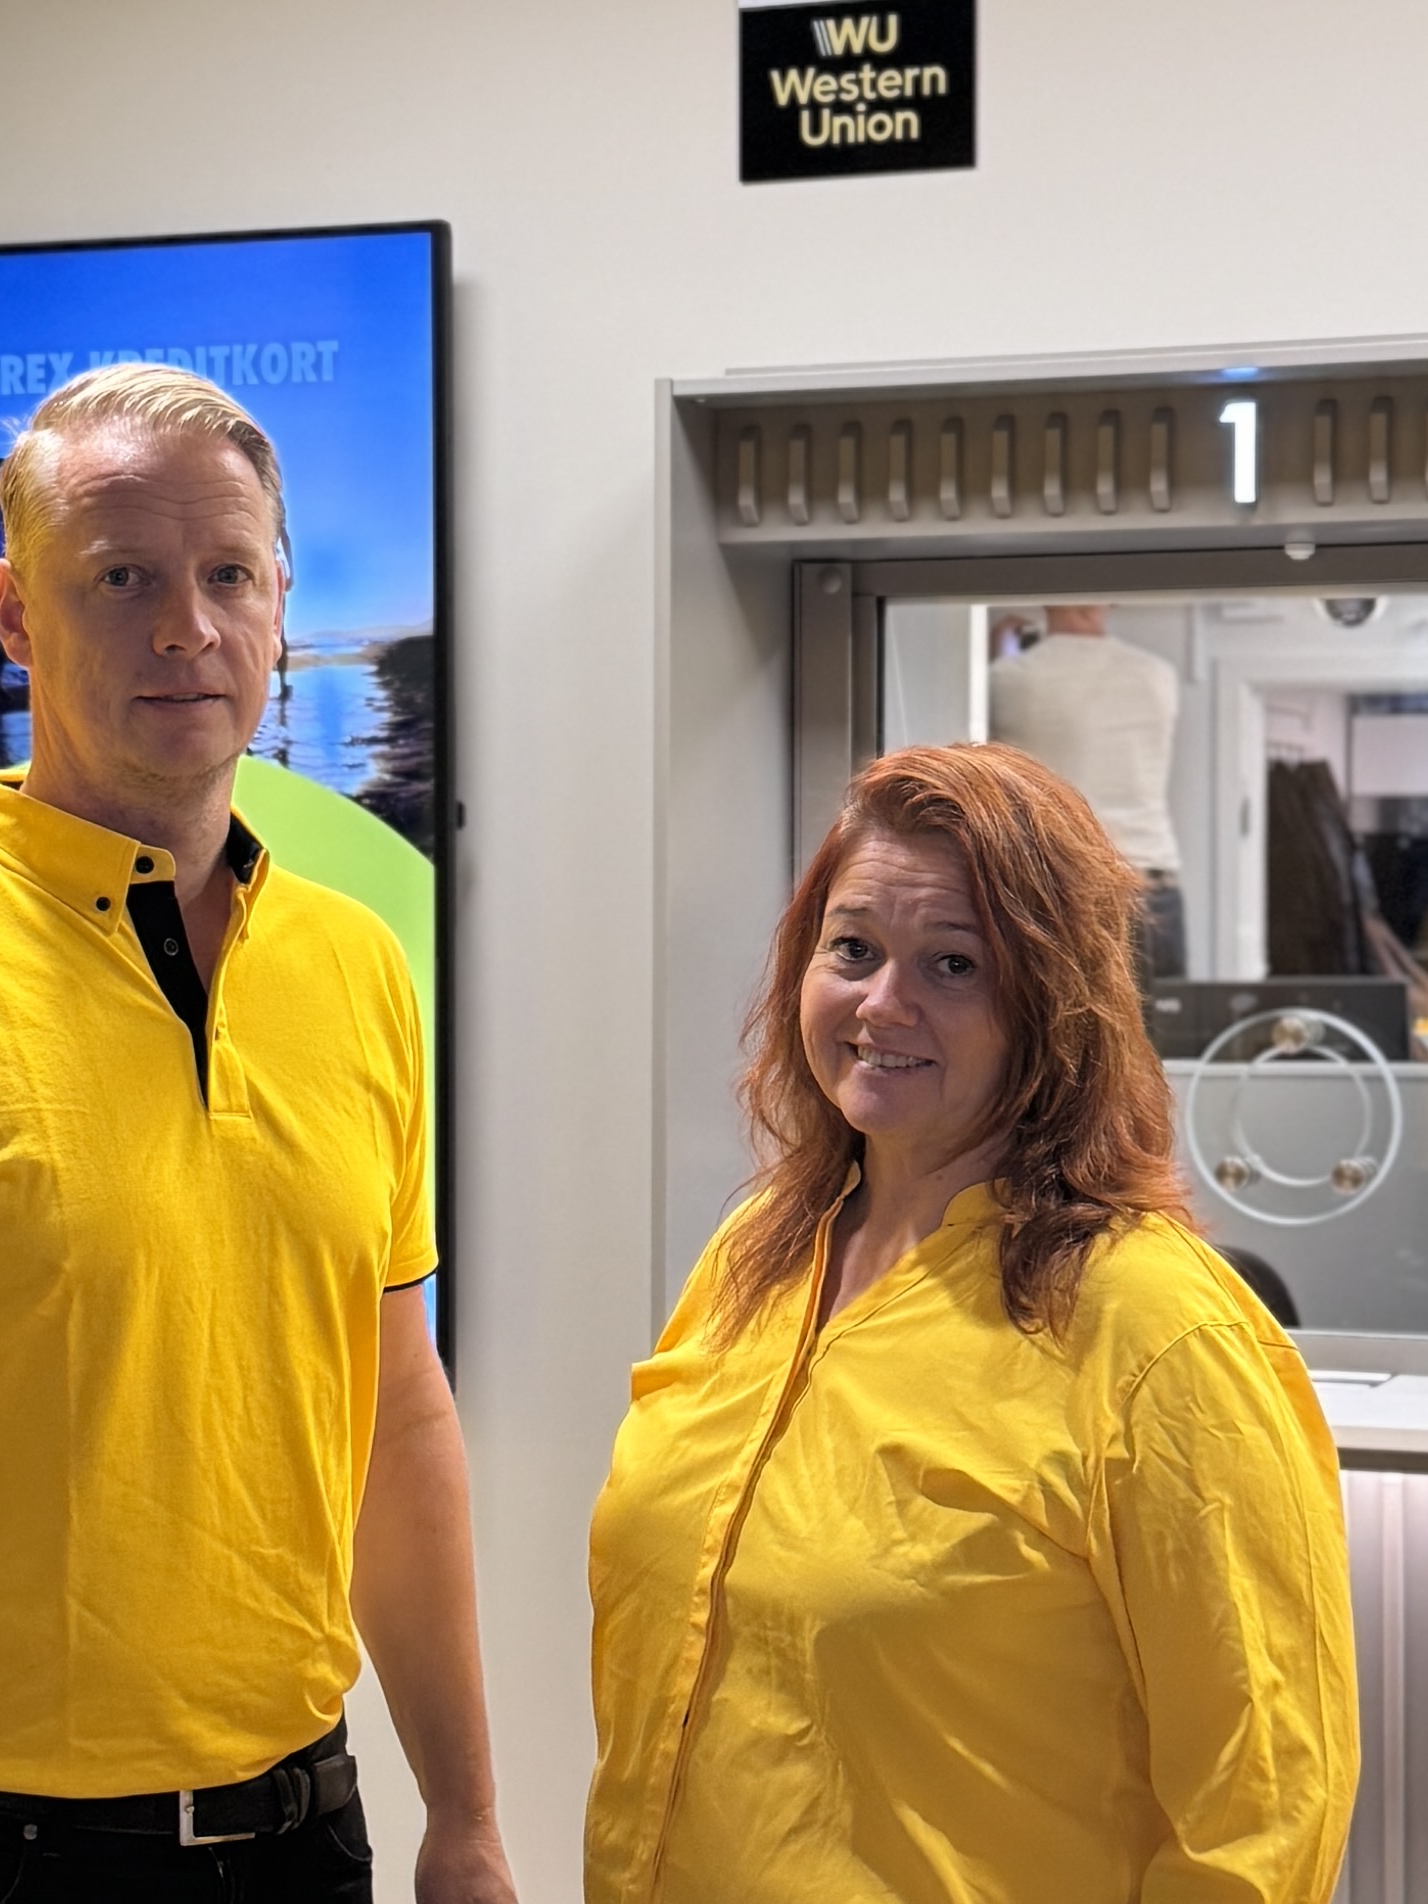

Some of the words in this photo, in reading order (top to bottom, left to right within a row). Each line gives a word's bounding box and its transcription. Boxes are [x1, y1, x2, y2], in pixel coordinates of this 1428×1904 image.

[817, 14, 898, 57] WU
[770, 63, 948, 107] Western
[800, 102, 920, 146] Union
[1219, 401, 1257, 504] 1
